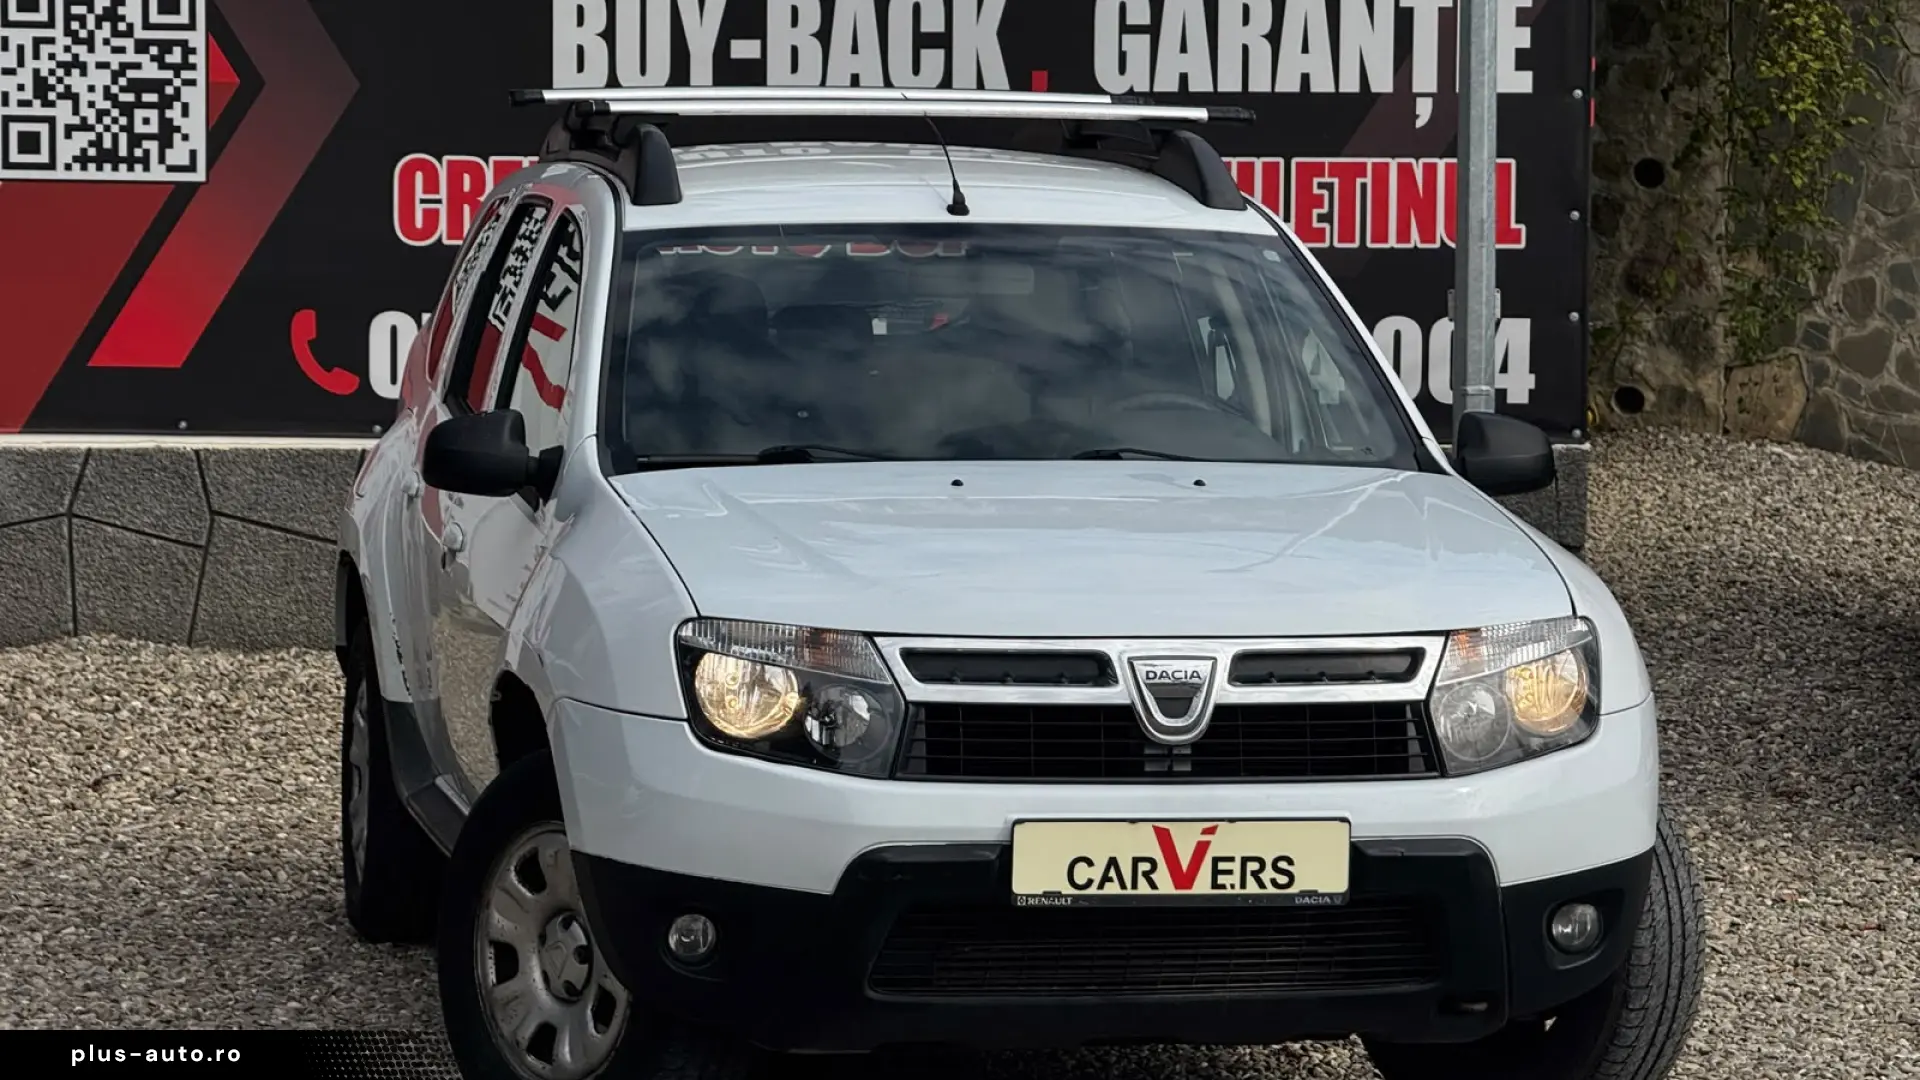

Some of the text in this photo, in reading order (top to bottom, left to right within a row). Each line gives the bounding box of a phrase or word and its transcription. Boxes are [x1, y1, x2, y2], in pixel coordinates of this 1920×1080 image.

[552, 0, 1533, 129] BUY-BACK GARANȚE
[393, 153, 539, 246] CR
[1145, 669, 1202, 681] DACIA
[1066, 823, 1297, 891] CARVERS
[1027, 895, 1332, 906] RENAULT DACIA
